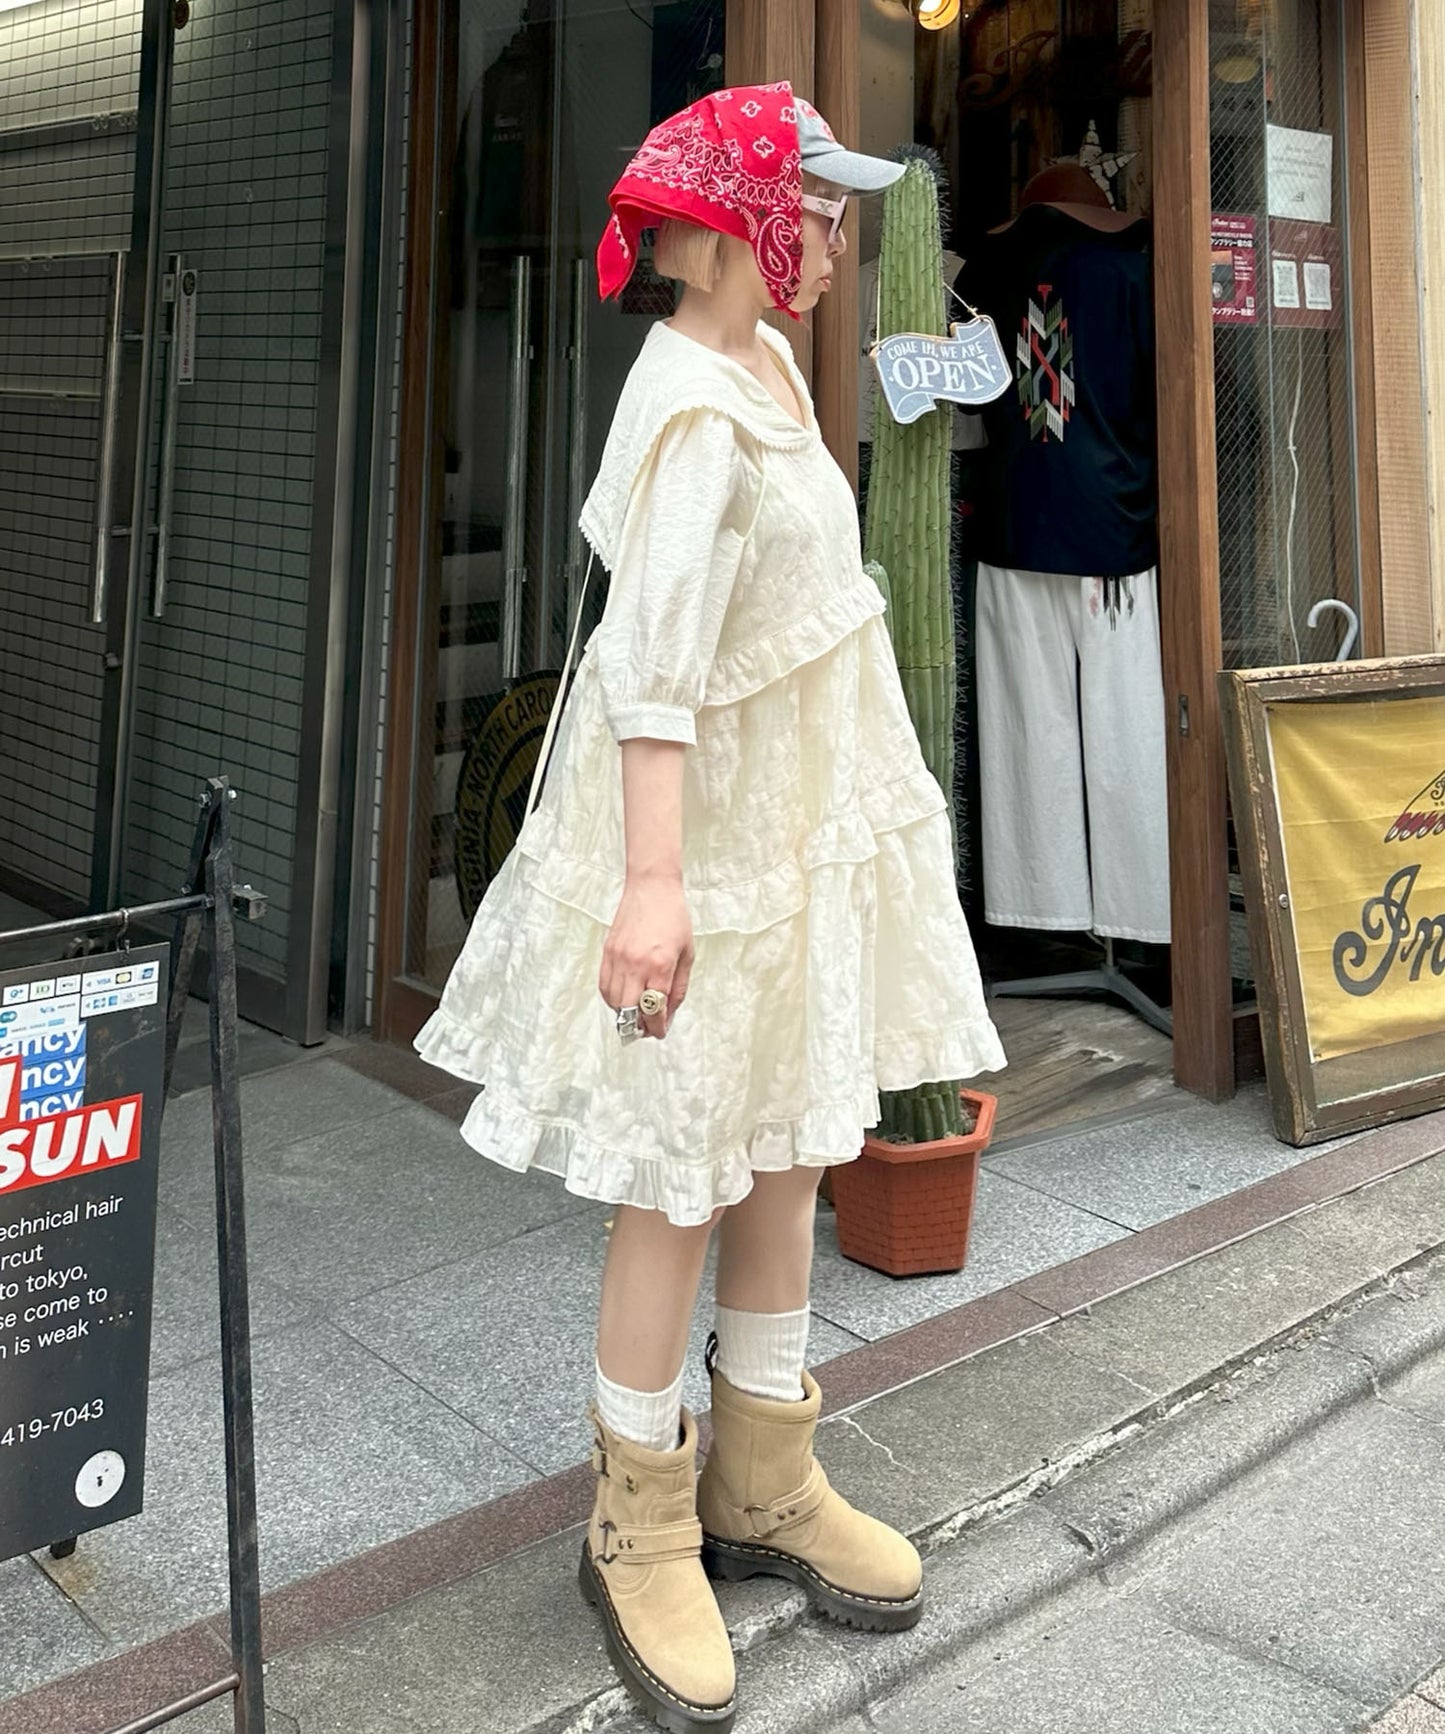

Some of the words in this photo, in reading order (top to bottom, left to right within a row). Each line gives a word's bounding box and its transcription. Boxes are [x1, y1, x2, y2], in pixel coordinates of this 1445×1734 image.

[887, 341, 919, 360] COME
[940, 346, 958, 359] WE
[961, 341, 984, 359] ARE
[892, 353, 997, 393] OPEN
[466, 722, 508, 799] NORTH
[85, 1194, 124, 1220] hair
[25, 1264, 88, 1293] tokyo,
[24, 1294, 81, 1323] come
[87, 1287, 108, 1306] to
[14, 1336, 31, 1356] is
[37, 1317, 90, 1348] weak
